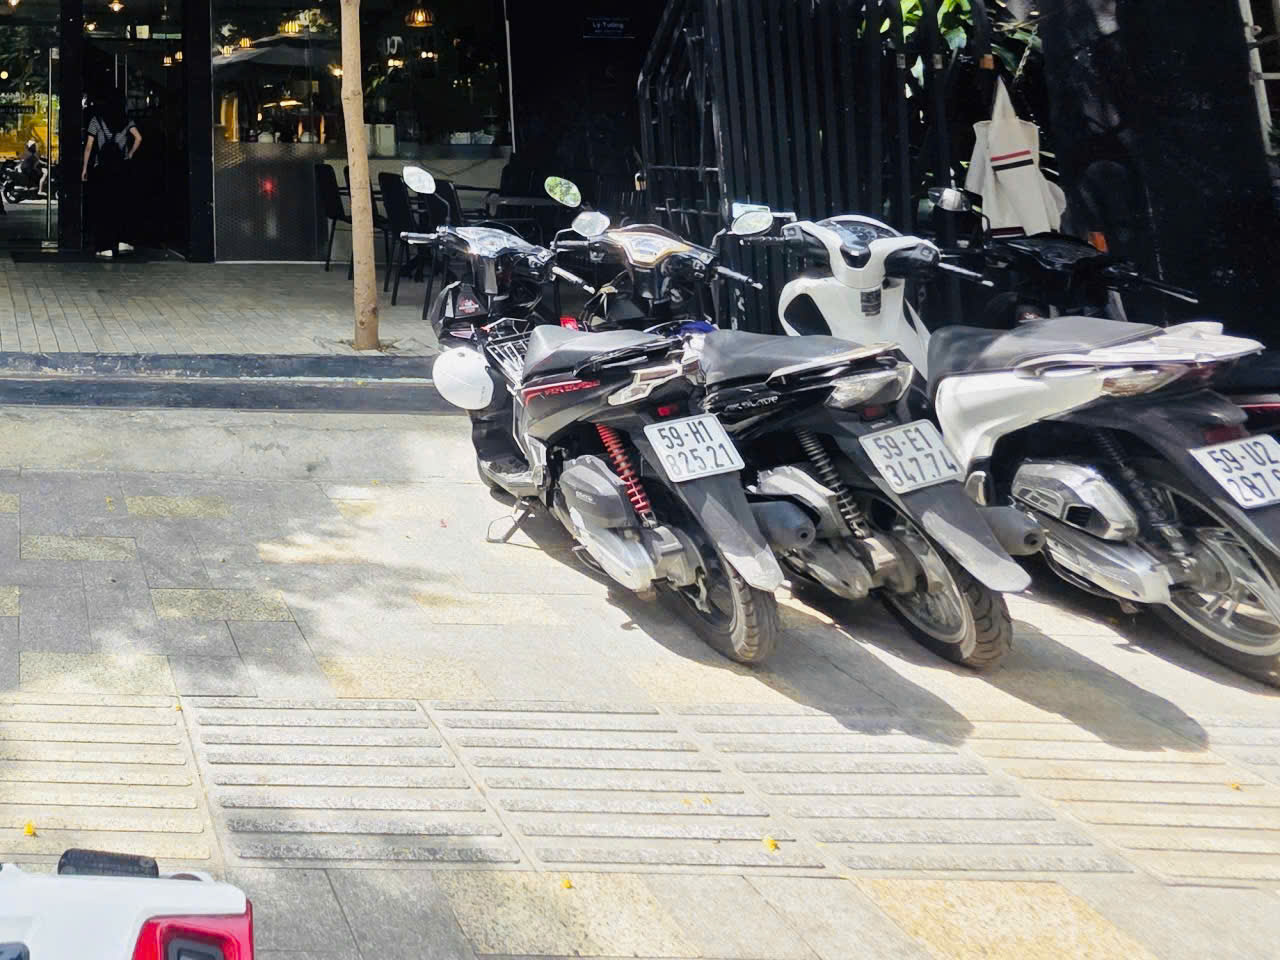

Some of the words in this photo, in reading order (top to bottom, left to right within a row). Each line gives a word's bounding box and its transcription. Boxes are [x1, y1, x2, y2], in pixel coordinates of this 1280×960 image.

[657, 420, 714, 449] 59-H1
[872, 426, 933, 460] 59-E1
[665, 442, 734, 476] 825.21
[885, 449, 958, 487] 347.74
[1207, 440, 1280, 474] 59-U2
